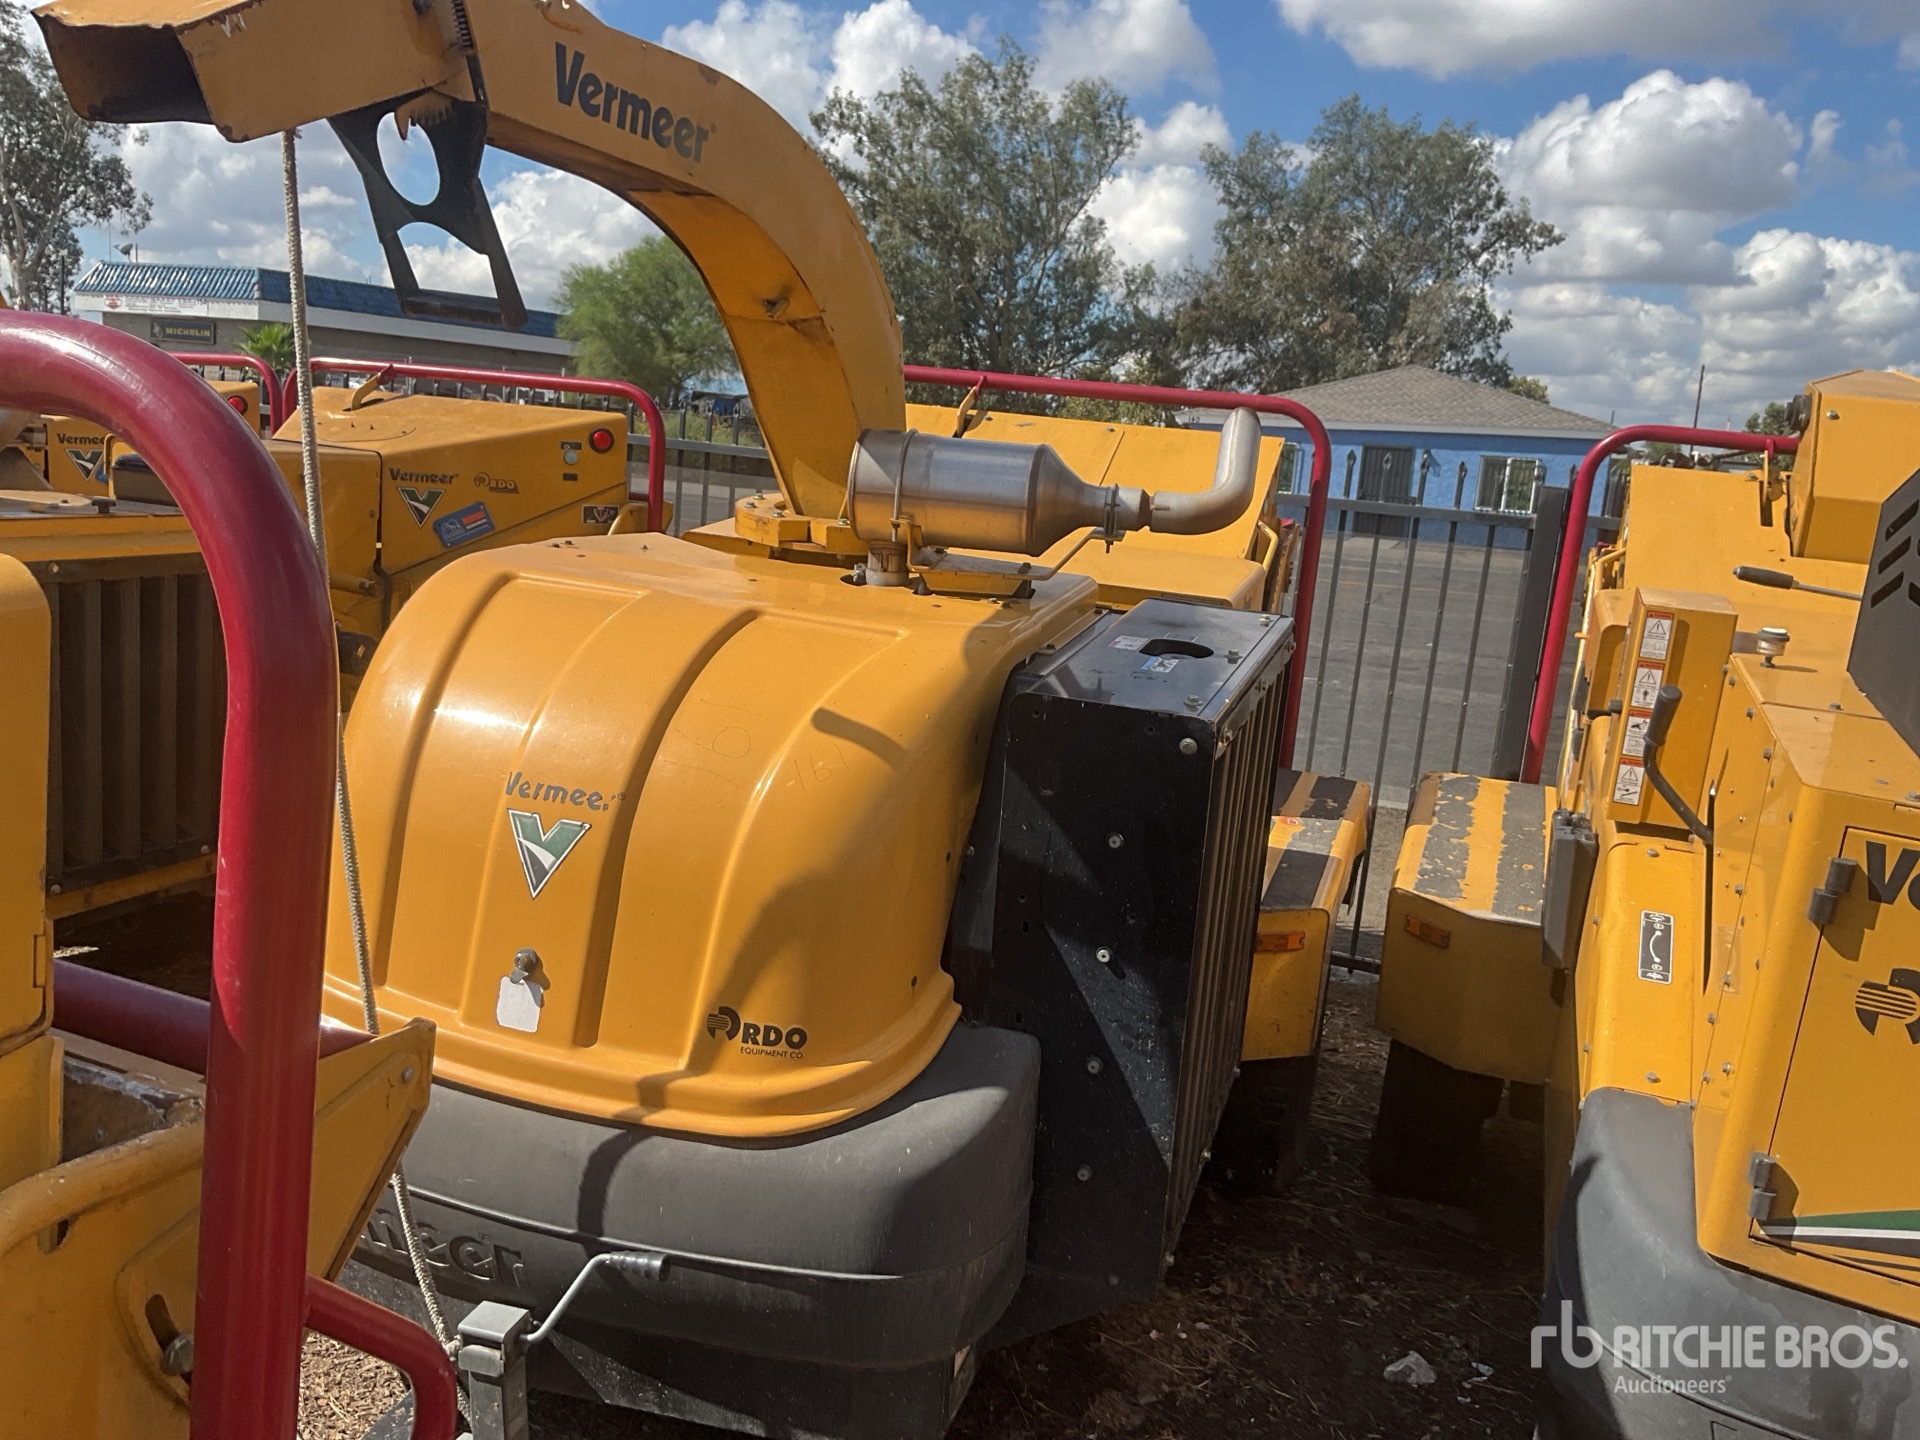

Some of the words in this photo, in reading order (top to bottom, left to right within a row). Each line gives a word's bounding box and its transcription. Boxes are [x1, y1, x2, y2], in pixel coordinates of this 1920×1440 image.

[555, 41, 710, 163] Vermeer
[165, 327, 211, 337] MICHELIN
[389, 468, 454, 484] Vermeer
[740, 1047, 788, 1058] EQUIPMENT
